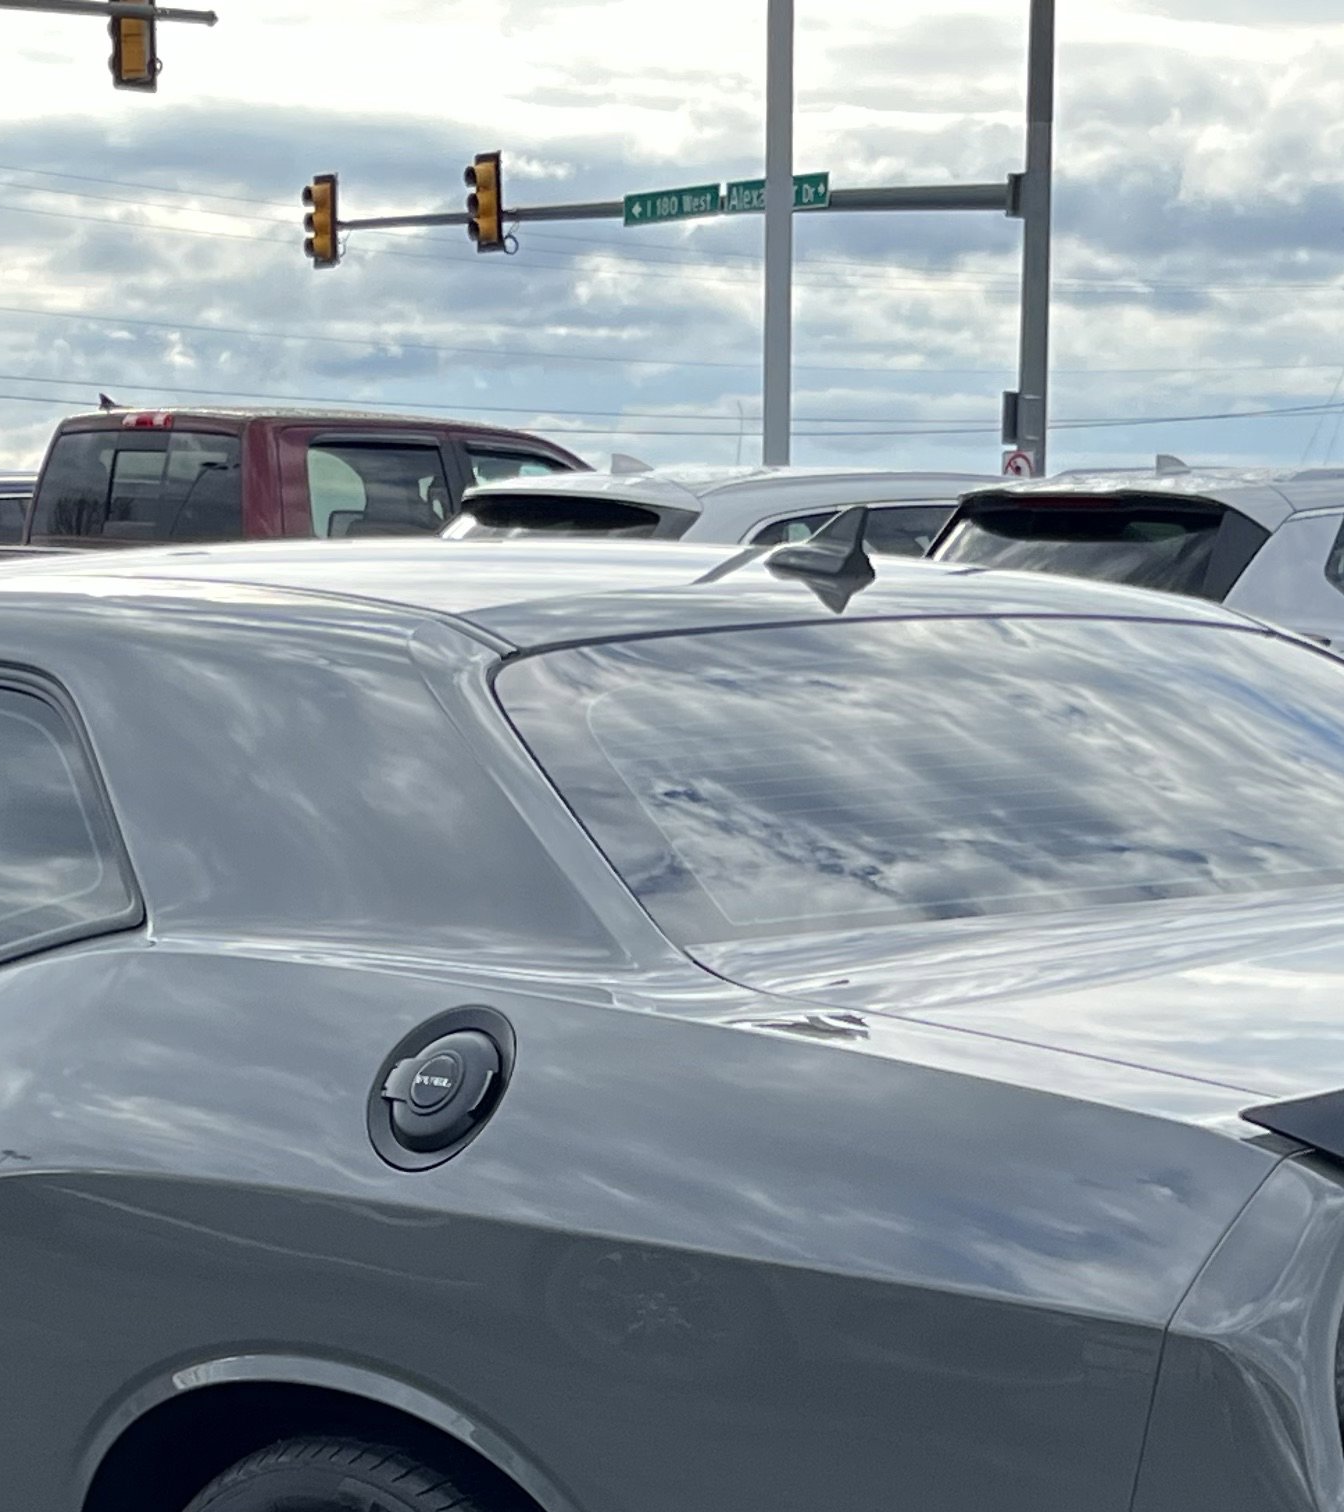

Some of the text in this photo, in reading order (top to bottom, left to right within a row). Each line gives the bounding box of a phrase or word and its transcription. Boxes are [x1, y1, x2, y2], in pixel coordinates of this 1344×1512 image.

[656, 196, 679, 217] 180
[682, 193, 712, 214] West
[801, 185, 816, 204] Dr
